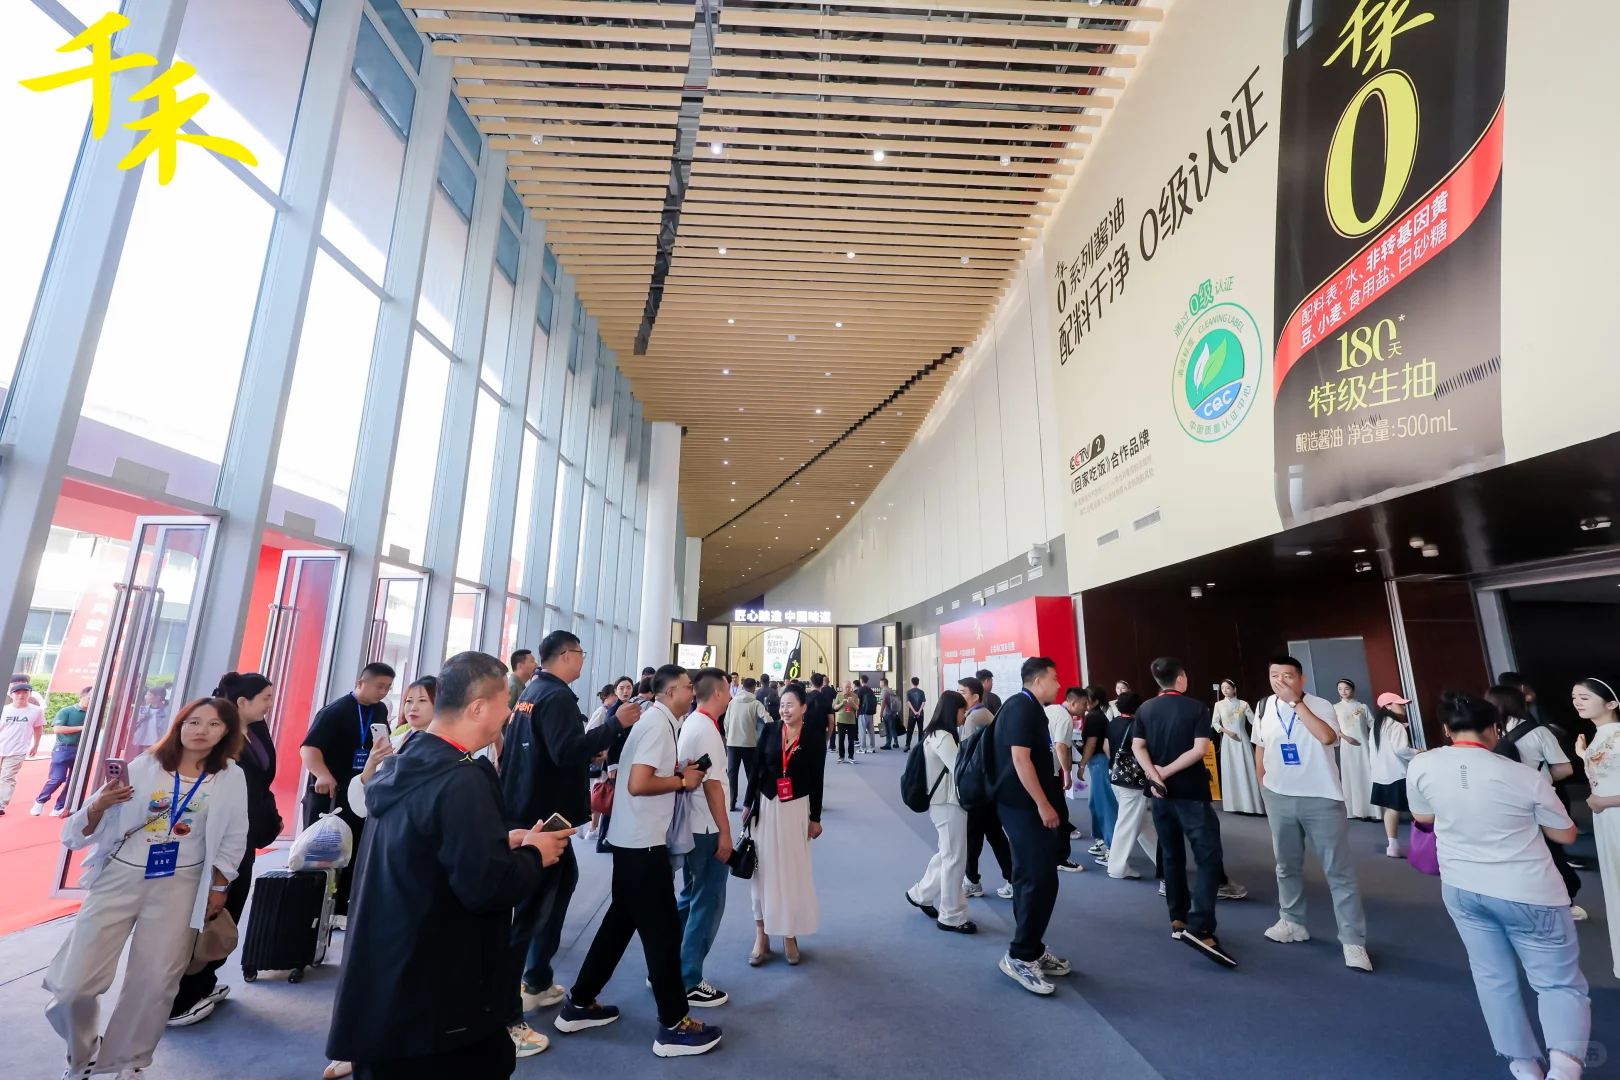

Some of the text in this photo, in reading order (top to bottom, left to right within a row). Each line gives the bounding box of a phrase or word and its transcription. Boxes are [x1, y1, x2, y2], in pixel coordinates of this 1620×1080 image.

[1324, 68, 1420, 239] 0
[1203, 389, 1233, 417] CQC
[1308, 357, 1437, 418] 特级生抽
[1295, 427, 1343, 452] 酿造酱油
